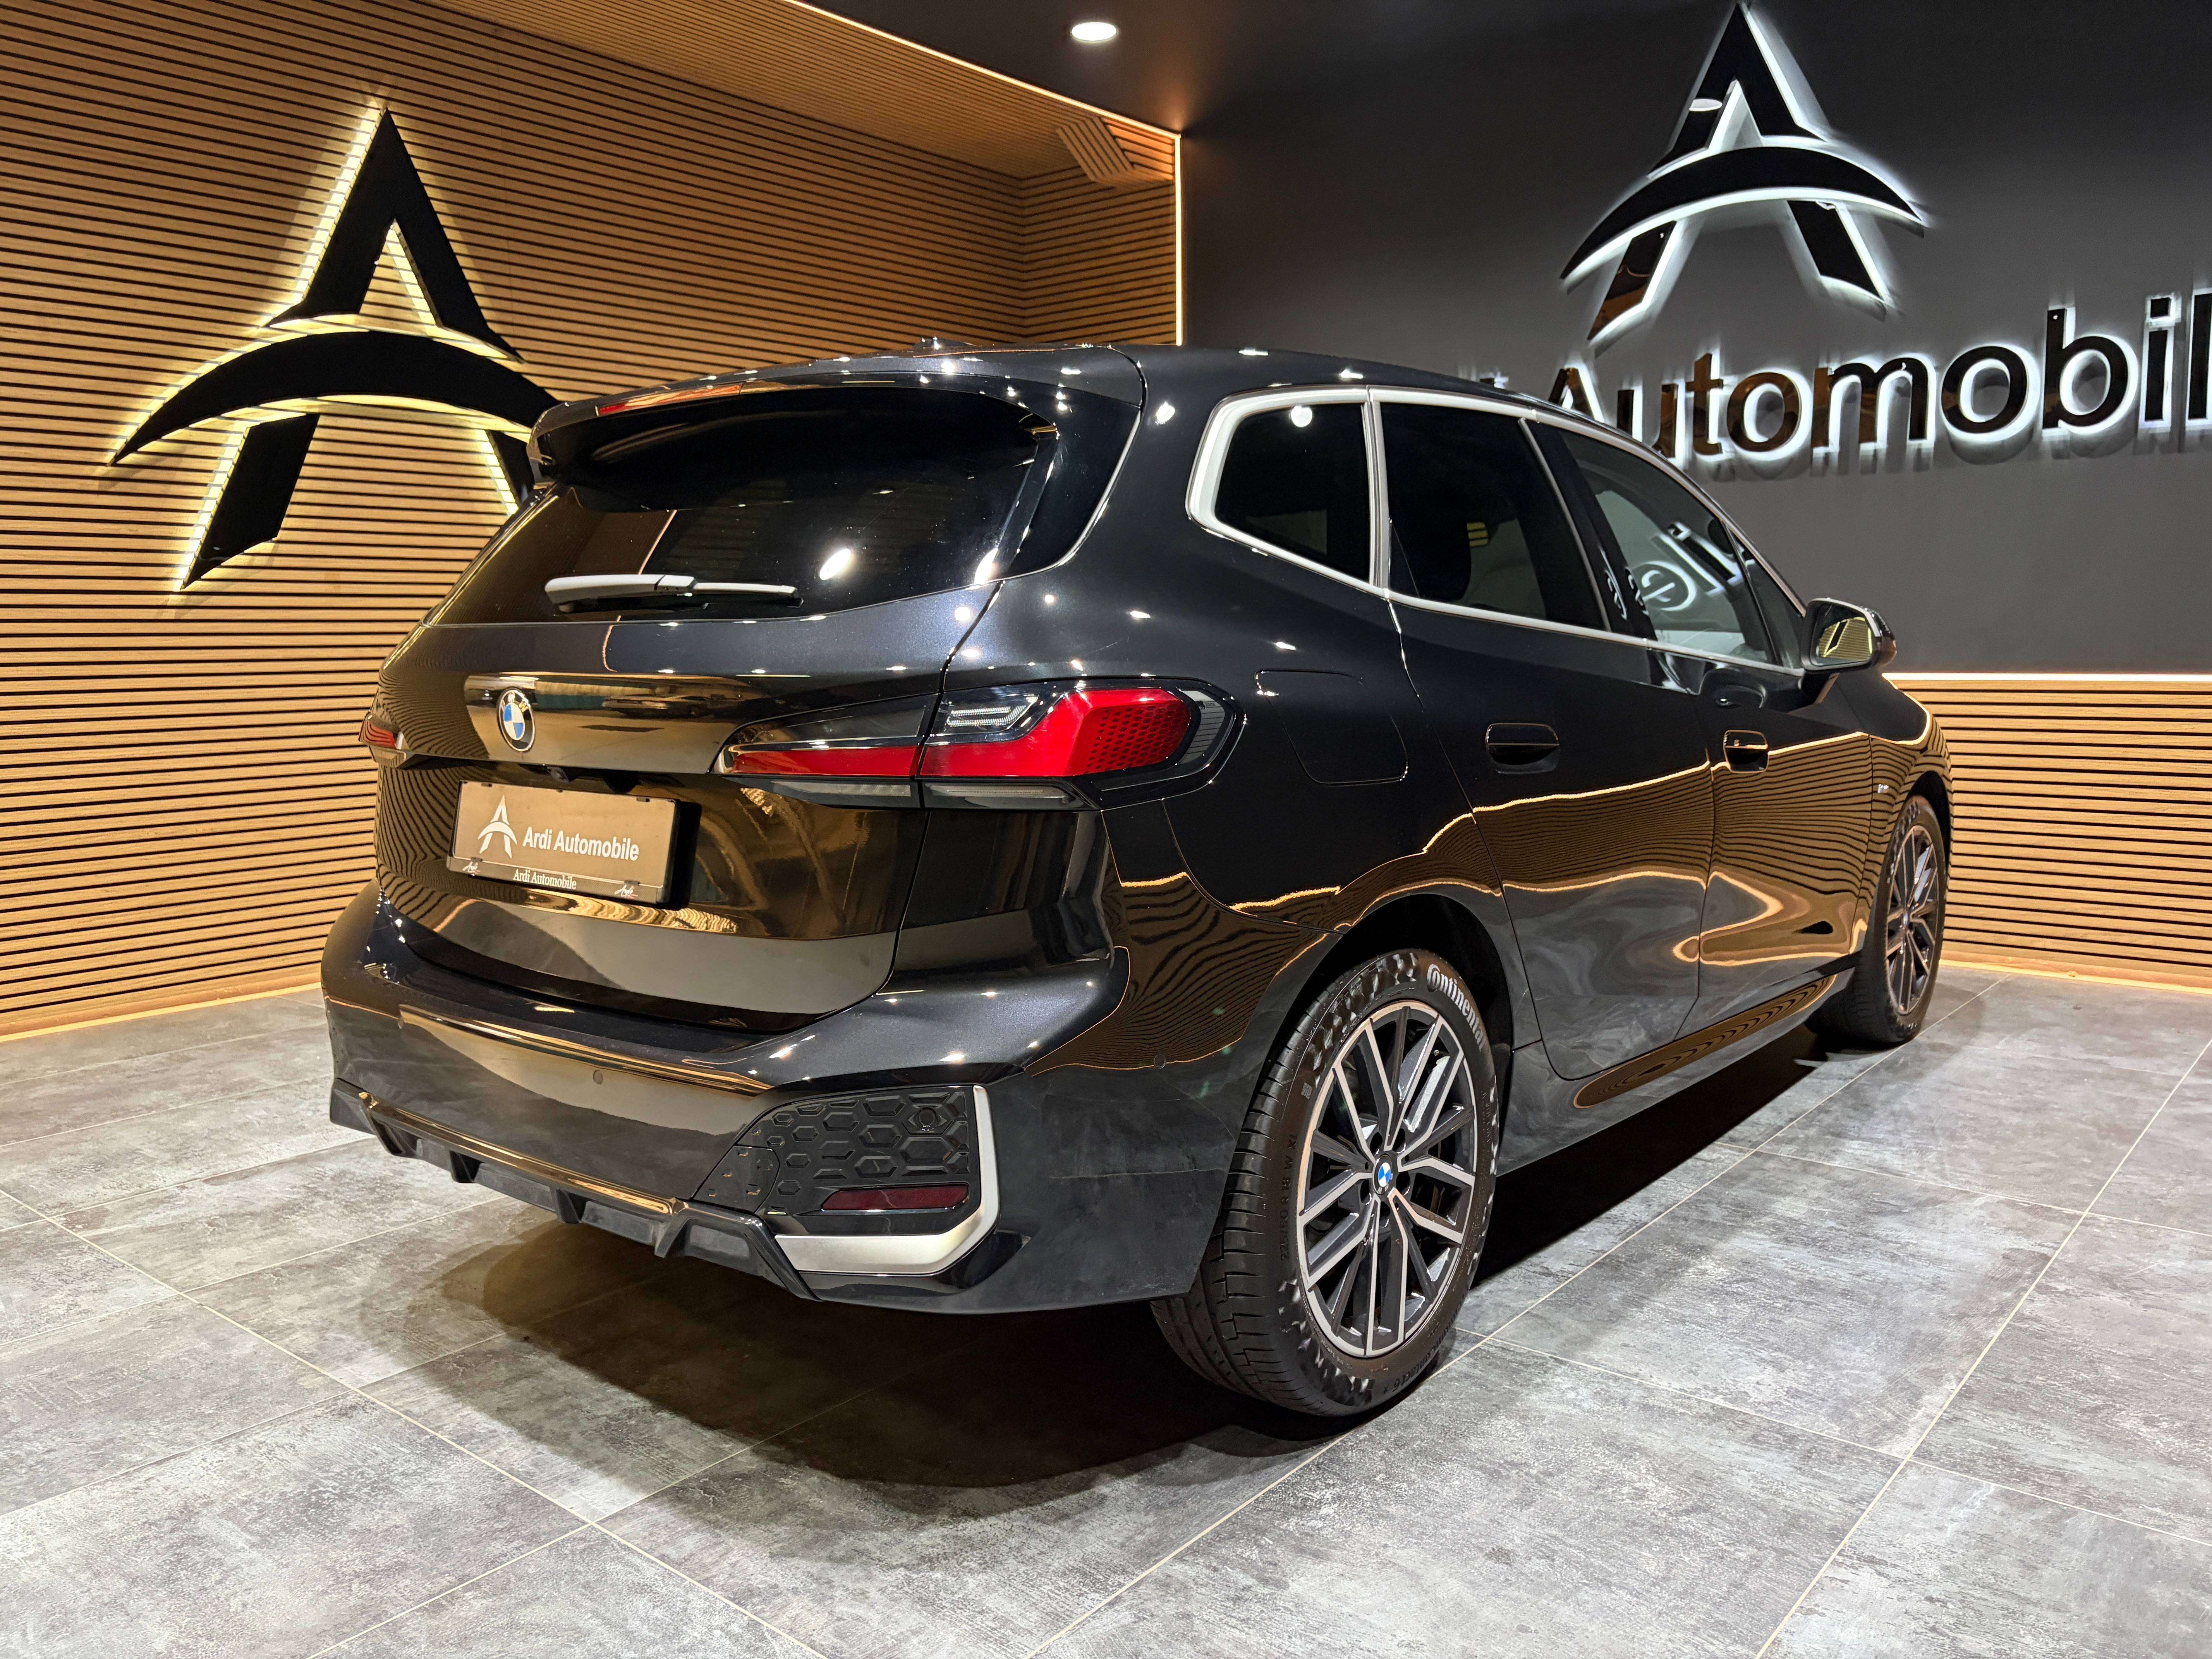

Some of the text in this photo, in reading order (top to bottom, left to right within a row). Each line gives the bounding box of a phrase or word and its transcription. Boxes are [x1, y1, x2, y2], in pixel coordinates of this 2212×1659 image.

[523, 826, 639, 861] Ardi Automobile
[513, 869, 577, 890] Ardi Automobile
[1427, 964, 1486, 1052] Continental
